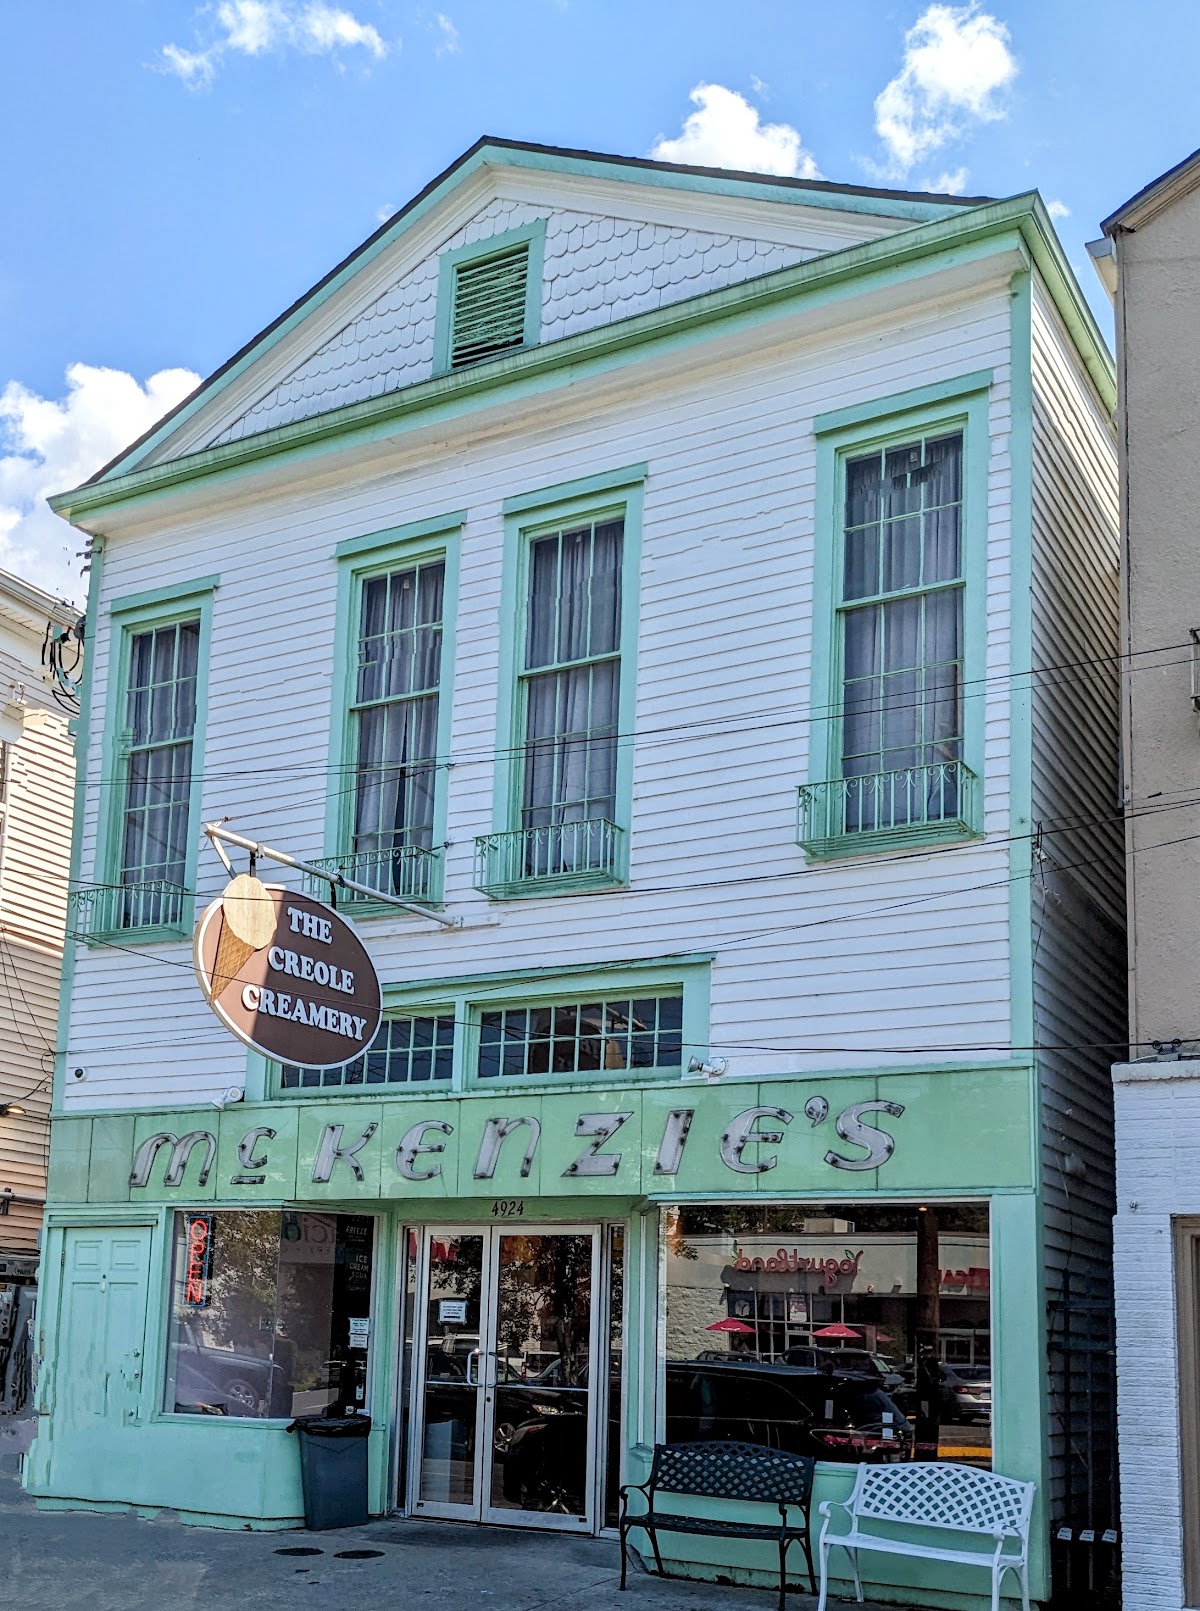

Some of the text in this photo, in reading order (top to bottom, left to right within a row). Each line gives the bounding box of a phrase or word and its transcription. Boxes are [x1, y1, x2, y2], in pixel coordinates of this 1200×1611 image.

[287, 906, 333, 945] THE
[267, 945, 355, 995] CREOLE
[241, 983, 367, 1041] CREAMERY
[491, 1200, 525, 1217] 4924
[346, 1226, 367, 1235] FREEZE
[186, 1220, 207, 1302] OPEN
[349, 1263, 368, 1272] CREAM
[355, 1255, 368, 1263] ICE
